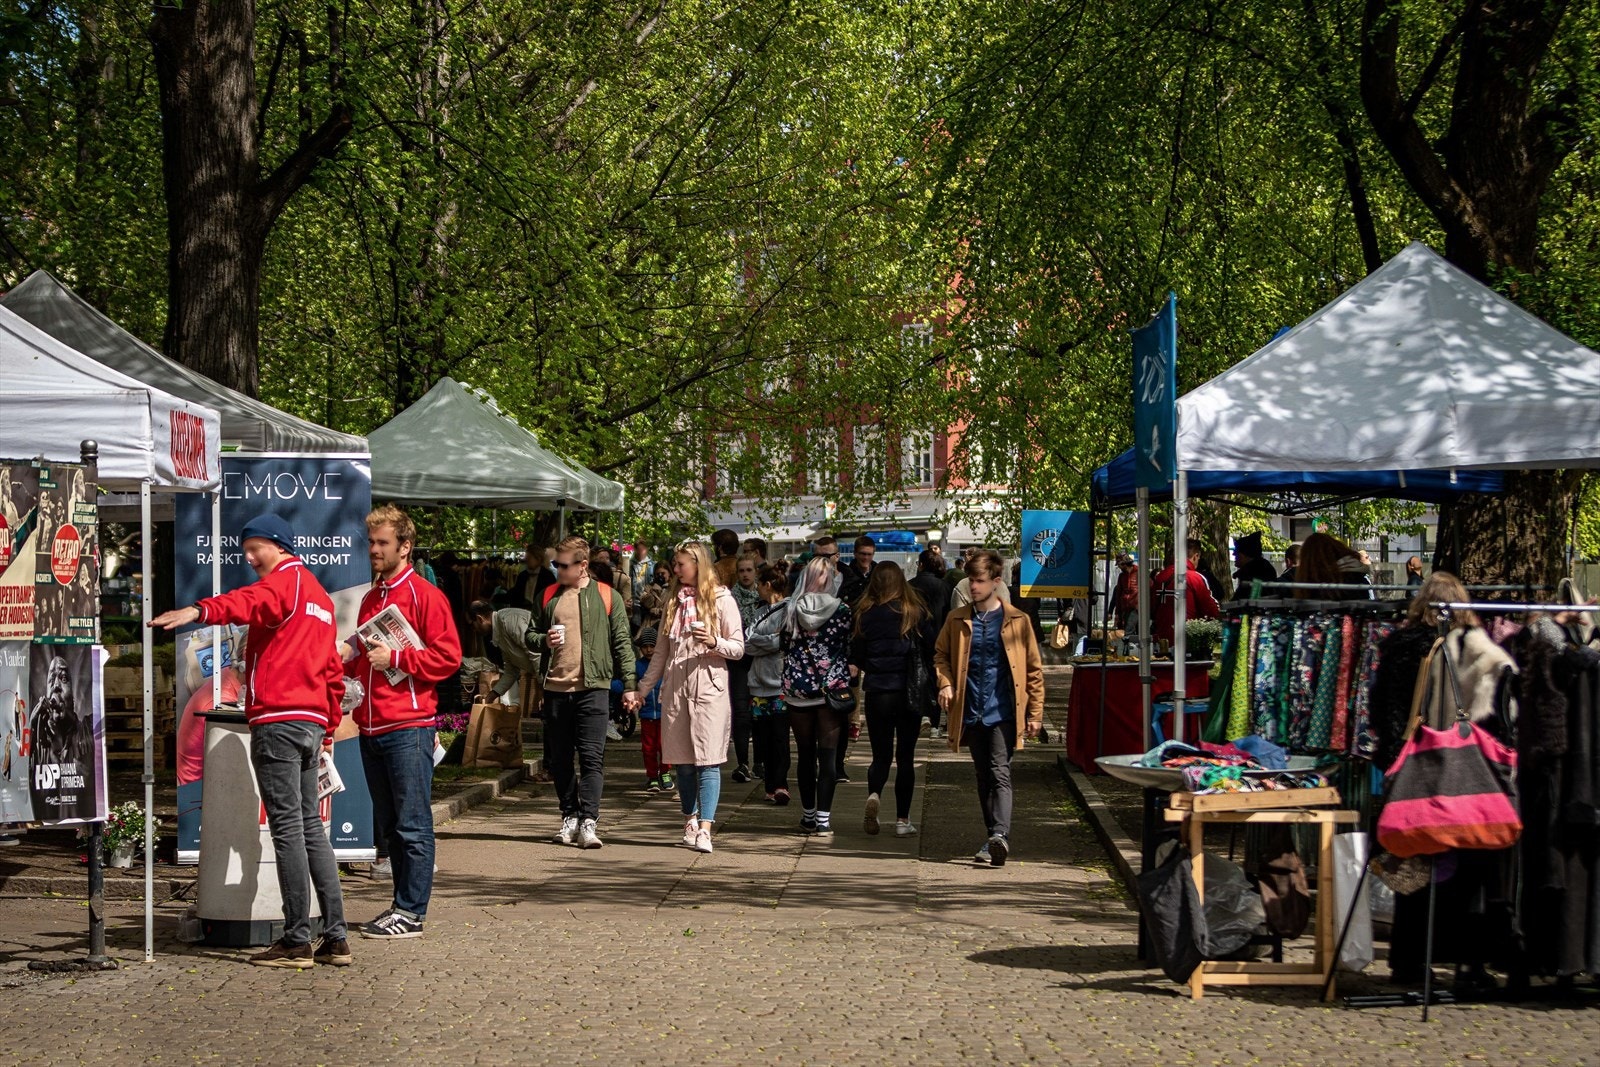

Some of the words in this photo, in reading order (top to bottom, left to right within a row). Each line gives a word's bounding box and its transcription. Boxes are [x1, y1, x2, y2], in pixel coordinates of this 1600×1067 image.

[202, 472, 343, 500] EMOVE
[54, 539, 79, 558] RETRO
[196, 535, 239, 547] FJRN
[35, 763, 60, 790] HDP
